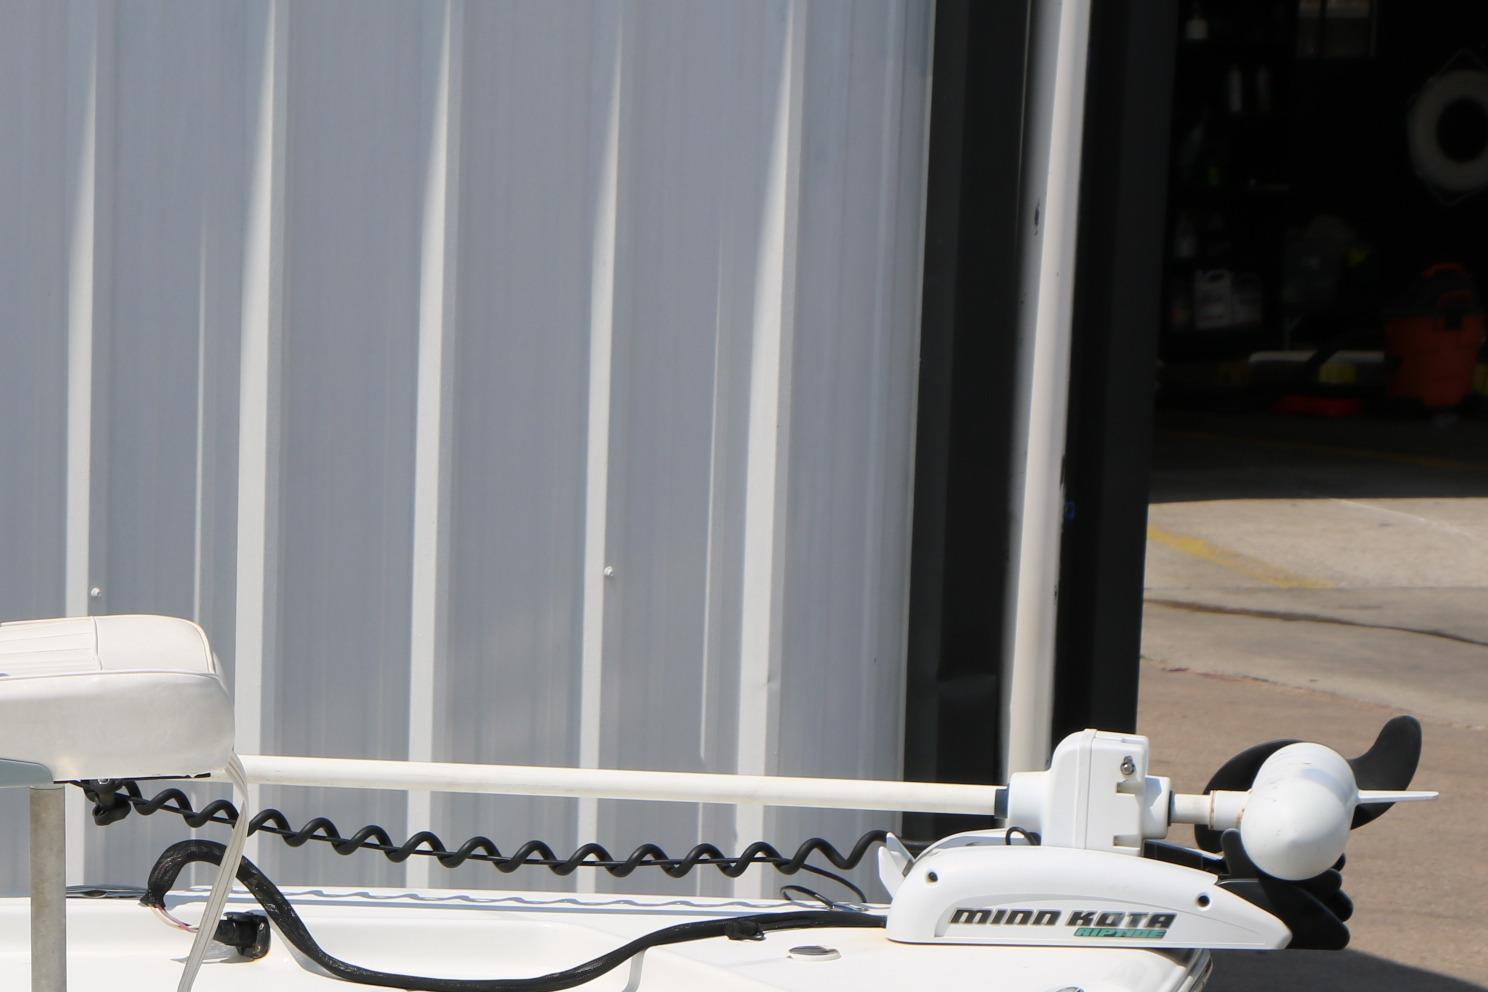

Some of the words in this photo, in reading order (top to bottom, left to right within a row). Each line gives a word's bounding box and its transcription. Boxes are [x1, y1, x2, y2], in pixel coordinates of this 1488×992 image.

[949, 909, 1063, 925] MINN
[1065, 911, 1178, 929] KOTA
[1075, 928, 1166, 939] RIPTIDE
